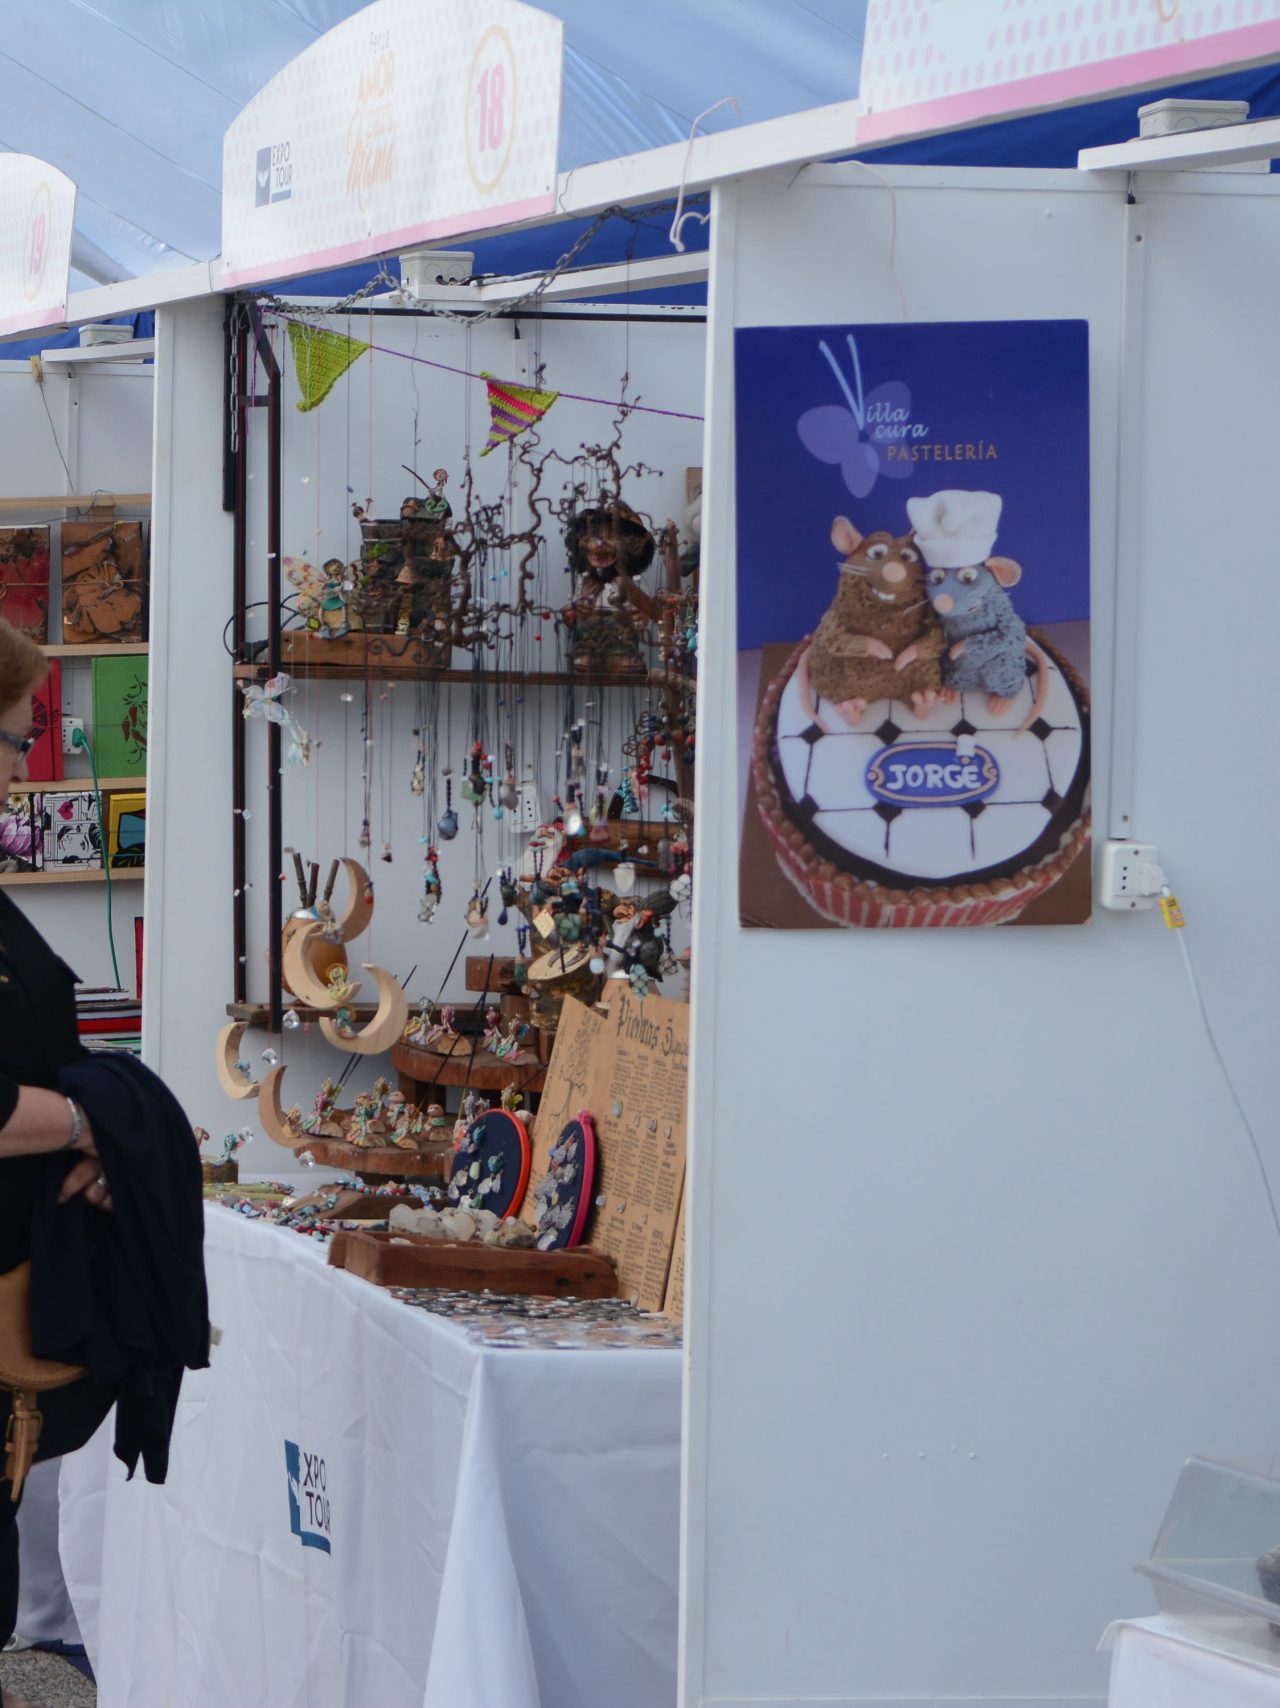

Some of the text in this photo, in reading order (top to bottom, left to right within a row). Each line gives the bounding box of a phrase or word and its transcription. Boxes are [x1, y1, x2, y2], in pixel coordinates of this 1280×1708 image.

[477, 63, 506, 153] 18
[272, 141, 291, 167] EXPO
[276, 164, 293, 189] TOUR
[887, 440, 998, 463] PASTELERÍA
[886, 764, 982, 790] JORGE
[303, 1451, 327, 1492] XPO
